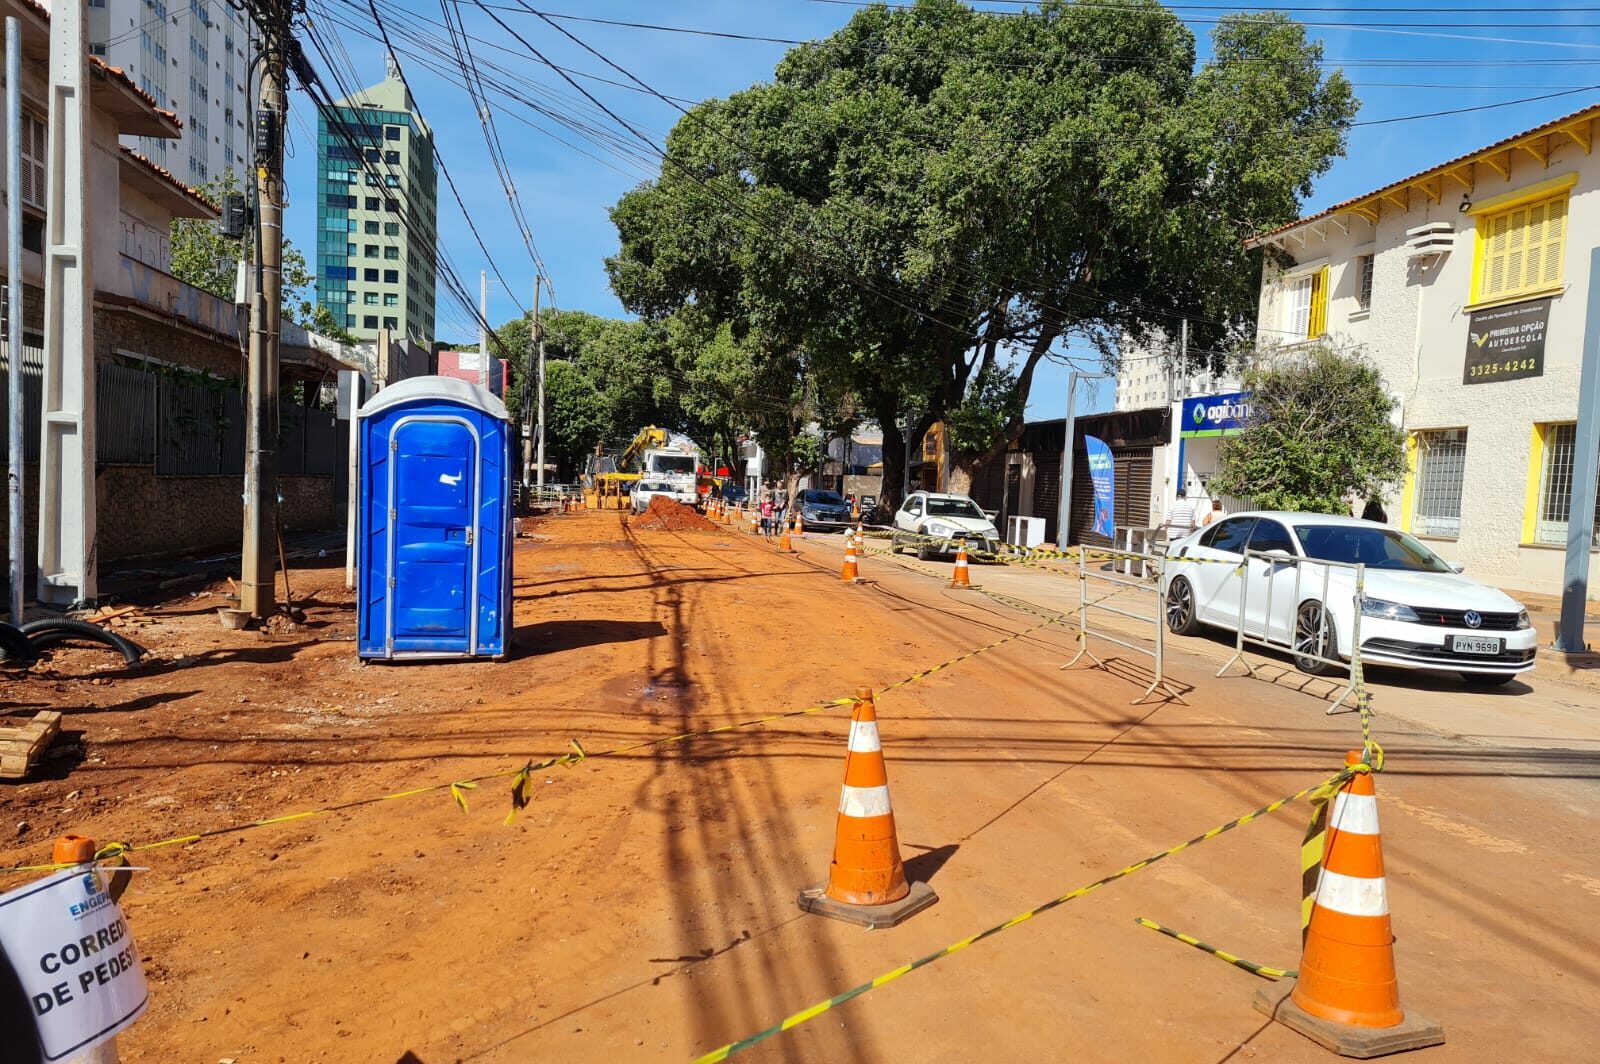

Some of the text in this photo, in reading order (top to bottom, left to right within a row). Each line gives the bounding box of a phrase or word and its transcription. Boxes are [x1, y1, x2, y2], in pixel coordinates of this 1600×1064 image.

[1489, 320, 1545, 338] PRIMEIRA OPÇÃO
[1488, 333, 1543, 348] AUTOESCOLA
[1470, 358, 1536, 377] 3325-4242
[1456, 641, 1473, 651] PYN
[31, 981, 74, 1017] DE
